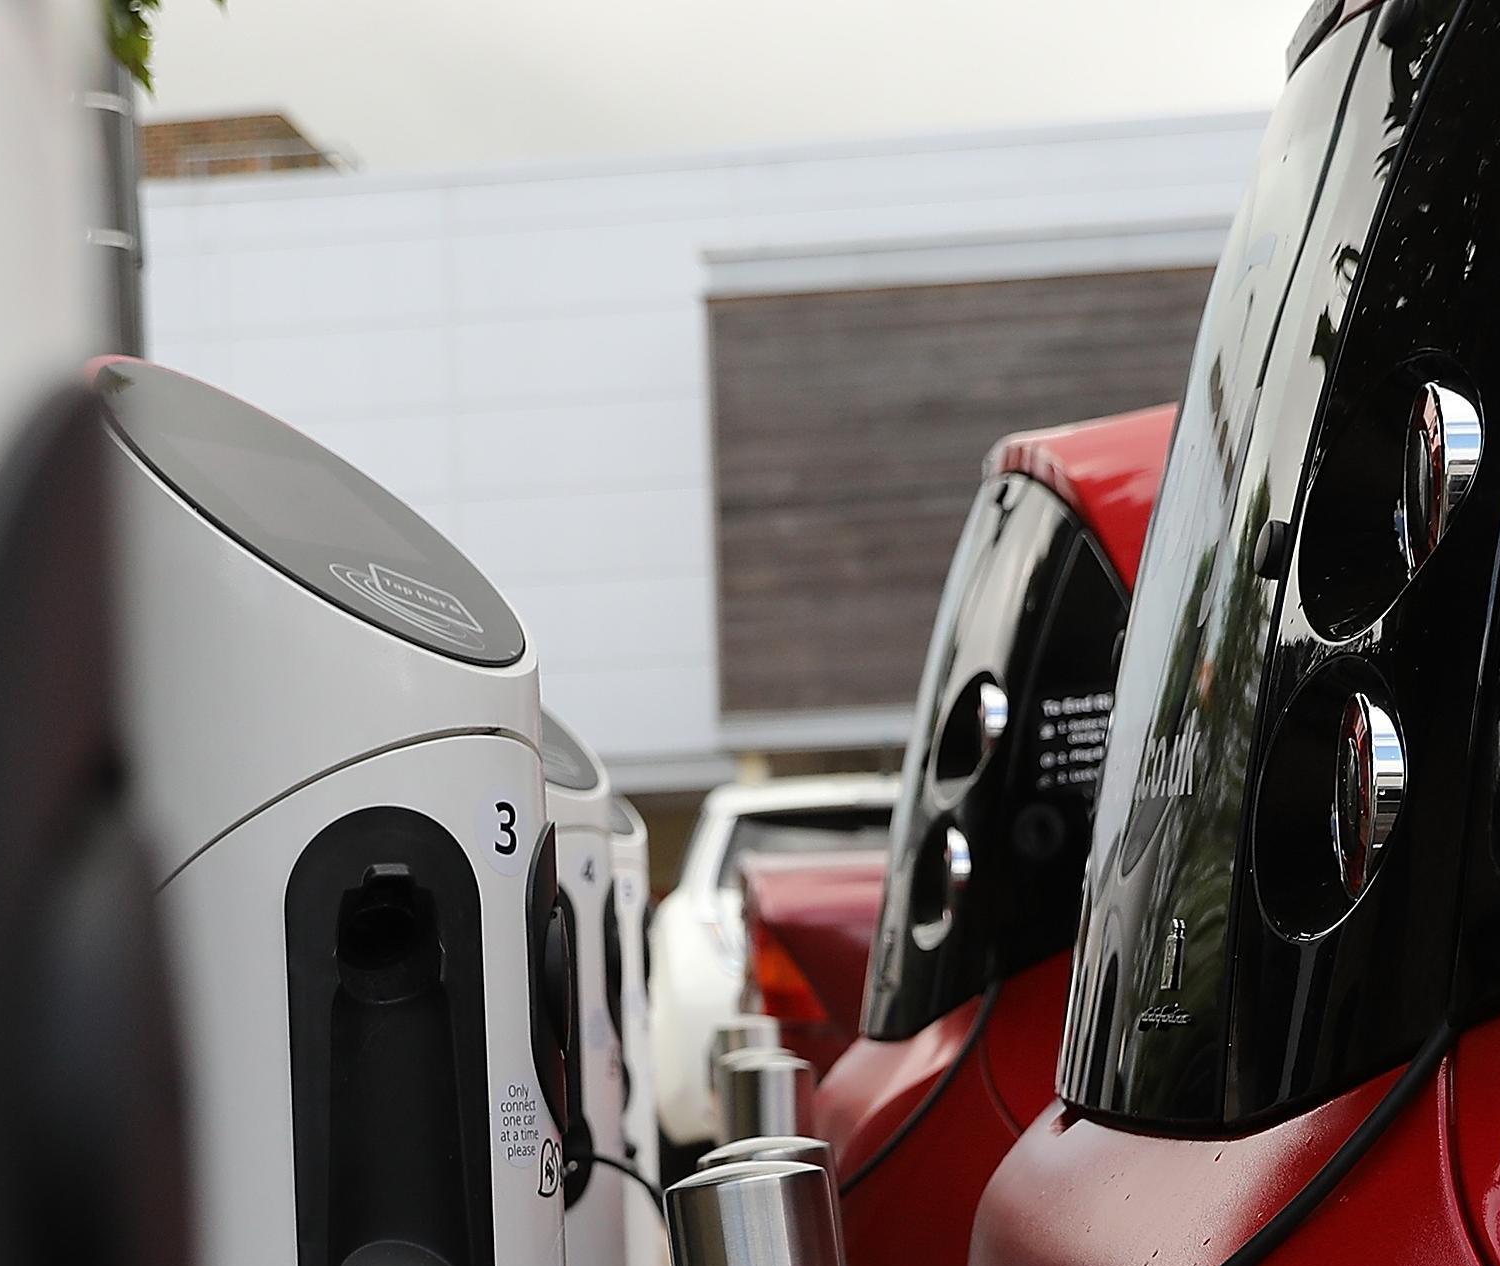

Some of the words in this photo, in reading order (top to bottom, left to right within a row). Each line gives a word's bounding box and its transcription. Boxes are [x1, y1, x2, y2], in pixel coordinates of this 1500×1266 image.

[494, 801, 518, 856] 3
[508, 1083, 530, 1100] Only
[500, 1099, 537, 1113] connect
[502, 1115, 521, 1127] one
[523, 1113, 537, 1126] car
[500, 1130, 512, 1143] at
[513, 1130, 519, 1141] a
[520, 1128, 540, 1142] time
[507, 1144, 537, 1160] please
